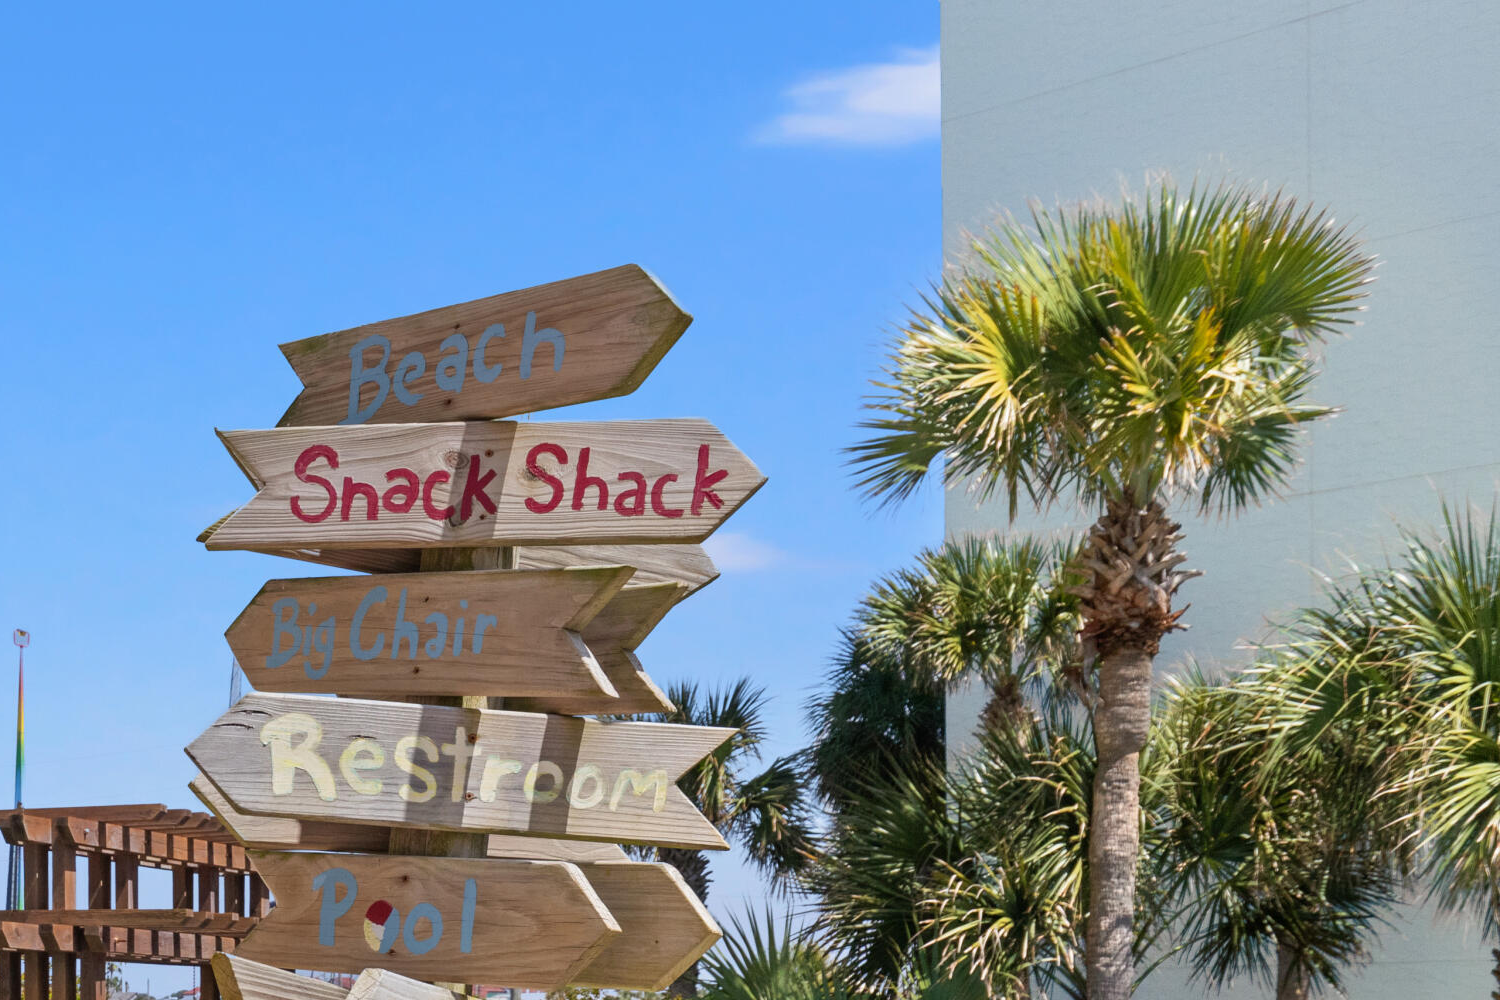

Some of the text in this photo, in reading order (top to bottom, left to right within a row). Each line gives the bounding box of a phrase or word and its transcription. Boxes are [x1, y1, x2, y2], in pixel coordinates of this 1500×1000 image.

[338, 310, 566, 425] Beach
[289, 441, 729, 523] Snack Shack
[265, 585, 498, 679] Big Chair
[260, 712, 668, 813] Restroom
[311, 866, 477, 955] Pool
